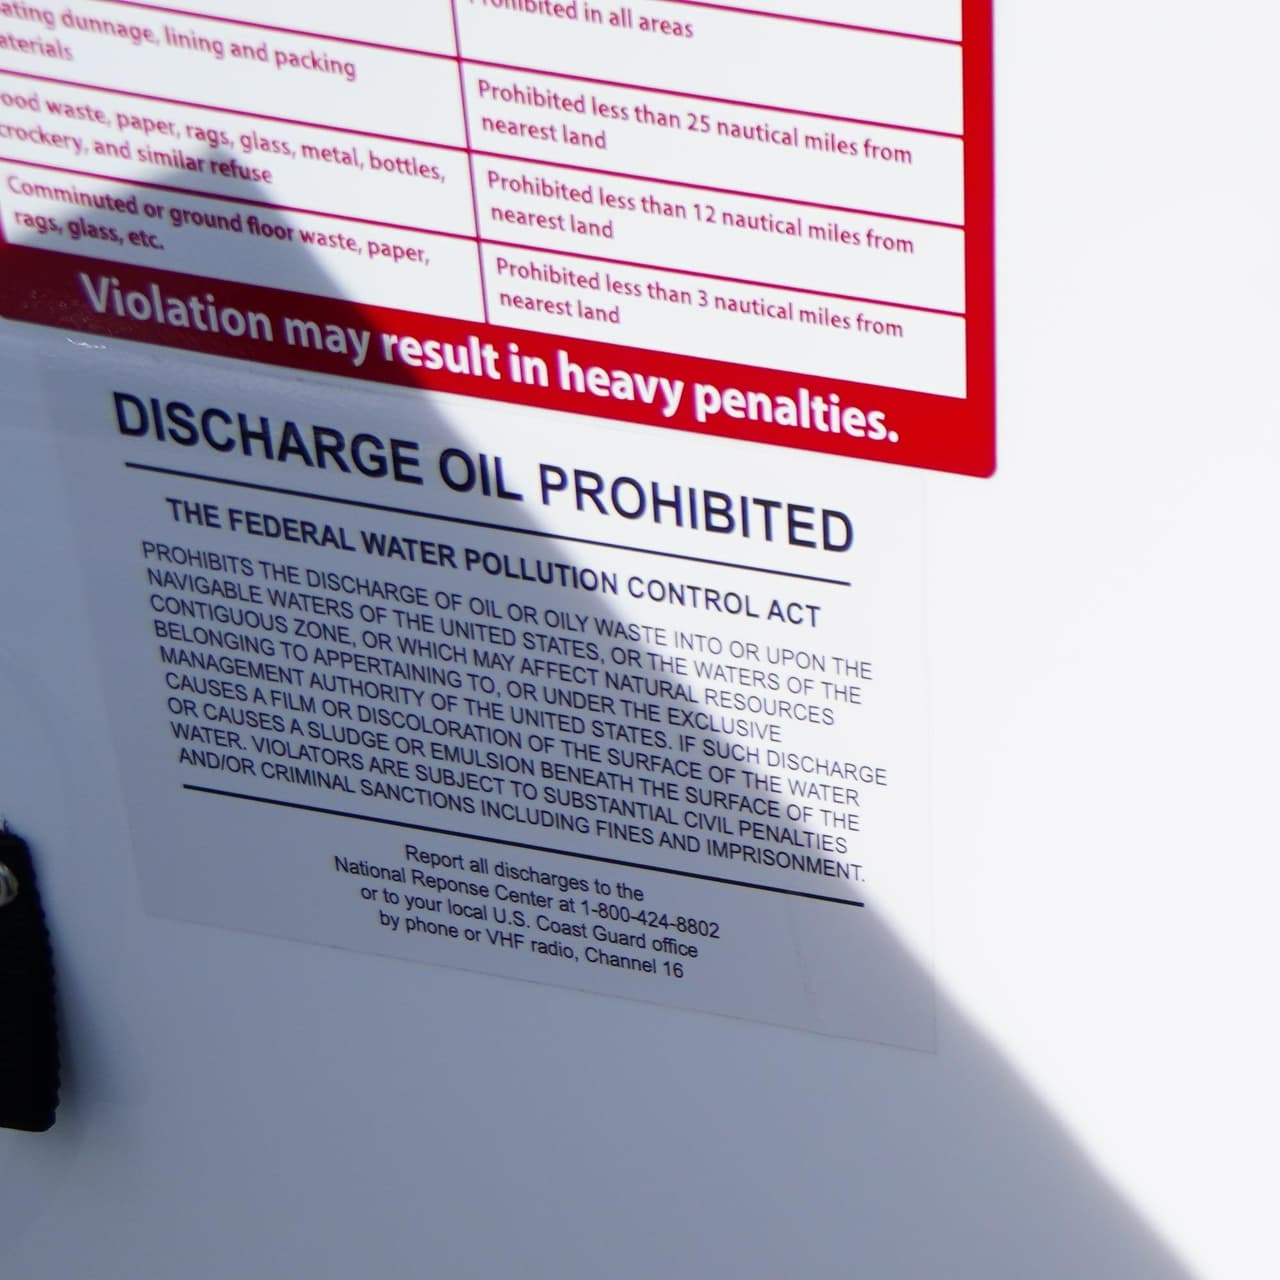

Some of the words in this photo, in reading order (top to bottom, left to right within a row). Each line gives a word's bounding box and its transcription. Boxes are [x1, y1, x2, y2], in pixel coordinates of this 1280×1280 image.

[584, 2, 604, 24] in
[608, 8, 633, 28] all
[638, 16, 695, 38] areas
[93, 140, 132, 160] and
[136, 148, 206, 173] similar
[209, 158, 272, 184] refuse
[477, 78, 586, 115] Prohibited
[591, 95, 630, 121] less
[633, 103, 681, 129] than
[687, 112, 711, 134] 25
[716, 121, 799, 147] nautical
[804, 132, 858, 156] miles
[863, 138, 912, 164] from
[481, 116, 558, 143] nearest
[562, 123, 607, 150] land
[368, 149, 446, 184] bottles,
[5, 174, 140, 216] Comminuted
[141, 202, 165, 220] or
[168, 207, 244, 233] ground
[245, 214, 294, 242] floor
[298, 229, 363, 255] waste,
[367, 240, 430, 266] paper,
[66, 216, 125, 246] glass,
[127, 229, 165, 251] etc.
[487, 169, 594, 205] Prohibited
[598, 186, 636, 212] less
[640, 194, 687, 219] than
[692, 202, 717, 224] 12
[721, 211, 803, 237] nautical
[808, 223, 861, 246] miles
[865, 228, 914, 254] from
[490, 206, 566, 232] nearest
[569, 213, 614, 239] land
[495, 256, 601, 291] Prohibited
[605, 273, 643, 298] less
[646, 281, 692, 305] than
[698, 289, 709, 308] 3
[714, 295, 794, 321] nautical
[799, 307, 851, 330] miles
[855, 312, 903, 338] from
[499, 292, 573, 317] nearest
[577, 299, 621, 325] land
[79, 272, 274, 342] Violation
[284, 317, 371, 367] may
[381, 333, 501, 380] result
[508, 342, 549, 387] in
[557, 349, 685, 418] heavy
[694, 383, 899, 443] penalties.
[112, 391, 424, 486] DISCHARGE
[438, 447, 524, 502] OIL
[539, 463, 854, 553] PROHIBITED
[141, 540, 255, 577] PROHIBITS
[258, 560, 302, 585] THE
[305, 568, 429, 607] DISCHARGE
[434, 591, 463, 612] OF
[468, 596, 503, 619] OIL
[507, 603, 539, 625] OR
[544, 609, 589, 633] OILY
[165, 497, 222, 529] THE
[227, 508, 357, 552] FEDERAL
[360, 530, 458, 569] WATER
[464, 547, 618, 595] POLLUTION
[627, 575, 760, 619] CONTROL
[767, 599, 821, 628] ACT
[147, 567, 263, 605] NAVIGABLE
[266, 588, 354, 620] WATERS
[359, 604, 387, 625] OF
[391, 609, 435, 634] THE
[440, 617, 517, 647] UNITED
[522, 631, 605, 665] STATES,
[610, 646, 643, 668] OR
[646, 652, 688, 676] THE
[149, 593, 289, 634] CONTIGUOUS
[293, 617, 357, 648] ZONE,
[361, 630, 393, 652] OR
[396, 635, 468, 665] WHICH
[472, 648, 515, 672] MAY
[519, 657, 600, 686] AFFECT
[604, 671, 699, 704] NATURAL
[153, 619, 276, 657] BELONGING
[279, 640, 309, 663] TO
[313, 647, 463, 689] APPERTAINING
[466, 673, 501, 698] TO,
[506, 680, 538, 702] OR
[543, 686, 616, 715] UNDER
[619, 698, 662, 723] THE
[159, 645, 305, 687] MANAGEMENT
[309, 671, 425, 707] AUTHORITY
[430, 692, 458, 713] OF
[463, 697, 505, 722] THE
[510, 705, 586, 735] UNITED
[591, 719, 672, 750] STATES.
[679, 734, 696, 753] IF
[165, 671, 249, 702] CAUSES
[252, 687, 268, 705] A
[270, 689, 317, 714] FILM
[321, 698, 353, 721] OR
[356, 704, 523, 750] DISCOLORATION
[527, 734, 555, 754] OF
[560, 739, 602, 763] THE
[607, 747, 703, 781] SURFACE
[708, 765, 736, 785] OF
[167, 696, 199, 718] OR
[202, 703, 286, 733] CAUSES
[290, 718, 305, 737] A
[307, 720, 390, 752] SLUDGE
[394, 736, 426, 758] OR
[430, 741, 535, 776] EMULSION
[540, 760, 634, 793] BENEATH
[638, 777, 680, 801] THE
[685, 785, 781, 819] SURFACE
[169, 721, 247, 751] WATER.
[250, 735, 365, 771] VIOLATORS
[368, 756, 410, 779] ARE
[415, 764, 505, 795] SUBJECT
[509, 780, 538, 801] TO
[543, 786, 679, 826] SUBSTANTIAL
[683, 810, 734, 835] CIVIL
[738, 819, 848, 854] PENALTIES
[179, 747, 257, 777] AND/OR
[260, 761, 356, 794] CRIMINAL
[360, 778, 476, 814] SANCTIONS
[480, 799, 590, 834] INCLUDING
[595, 819, 655, 846] FINES
[659, 831, 701, 853] AND
[334, 855, 407, 883] National
[410, 868, 490, 898] Reponse
[494, 883, 554, 909] Center
[558, 897, 576, 914] at
[580, 899, 720, 939] 1-800-424-8802
[405, 844, 465, 871] Report
[469, 857, 489, 875] all
[493, 861, 590, 893] discharges
[593, 879, 612, 896] to
[616, 882, 644, 902] the
[360, 887, 379, 901] or
[382, 887, 400, 905] to
[404, 894, 443, 913] your
[447, 898, 488, 921] local
[492, 906, 531, 929] U.S.
[535, 914, 588, 939] Coast
[592, 924, 647, 949] Guard
[652, 936, 699, 959] office
[379, 909, 400, 932] by
[405, 916, 459, 938] phone
[464, 928, 482, 942] or
[485, 928, 525, 949] VHF
[530, 940, 579, 962] radio,
[584, 946, 657, 974] Channel
[663, 960, 684, 979] 16
